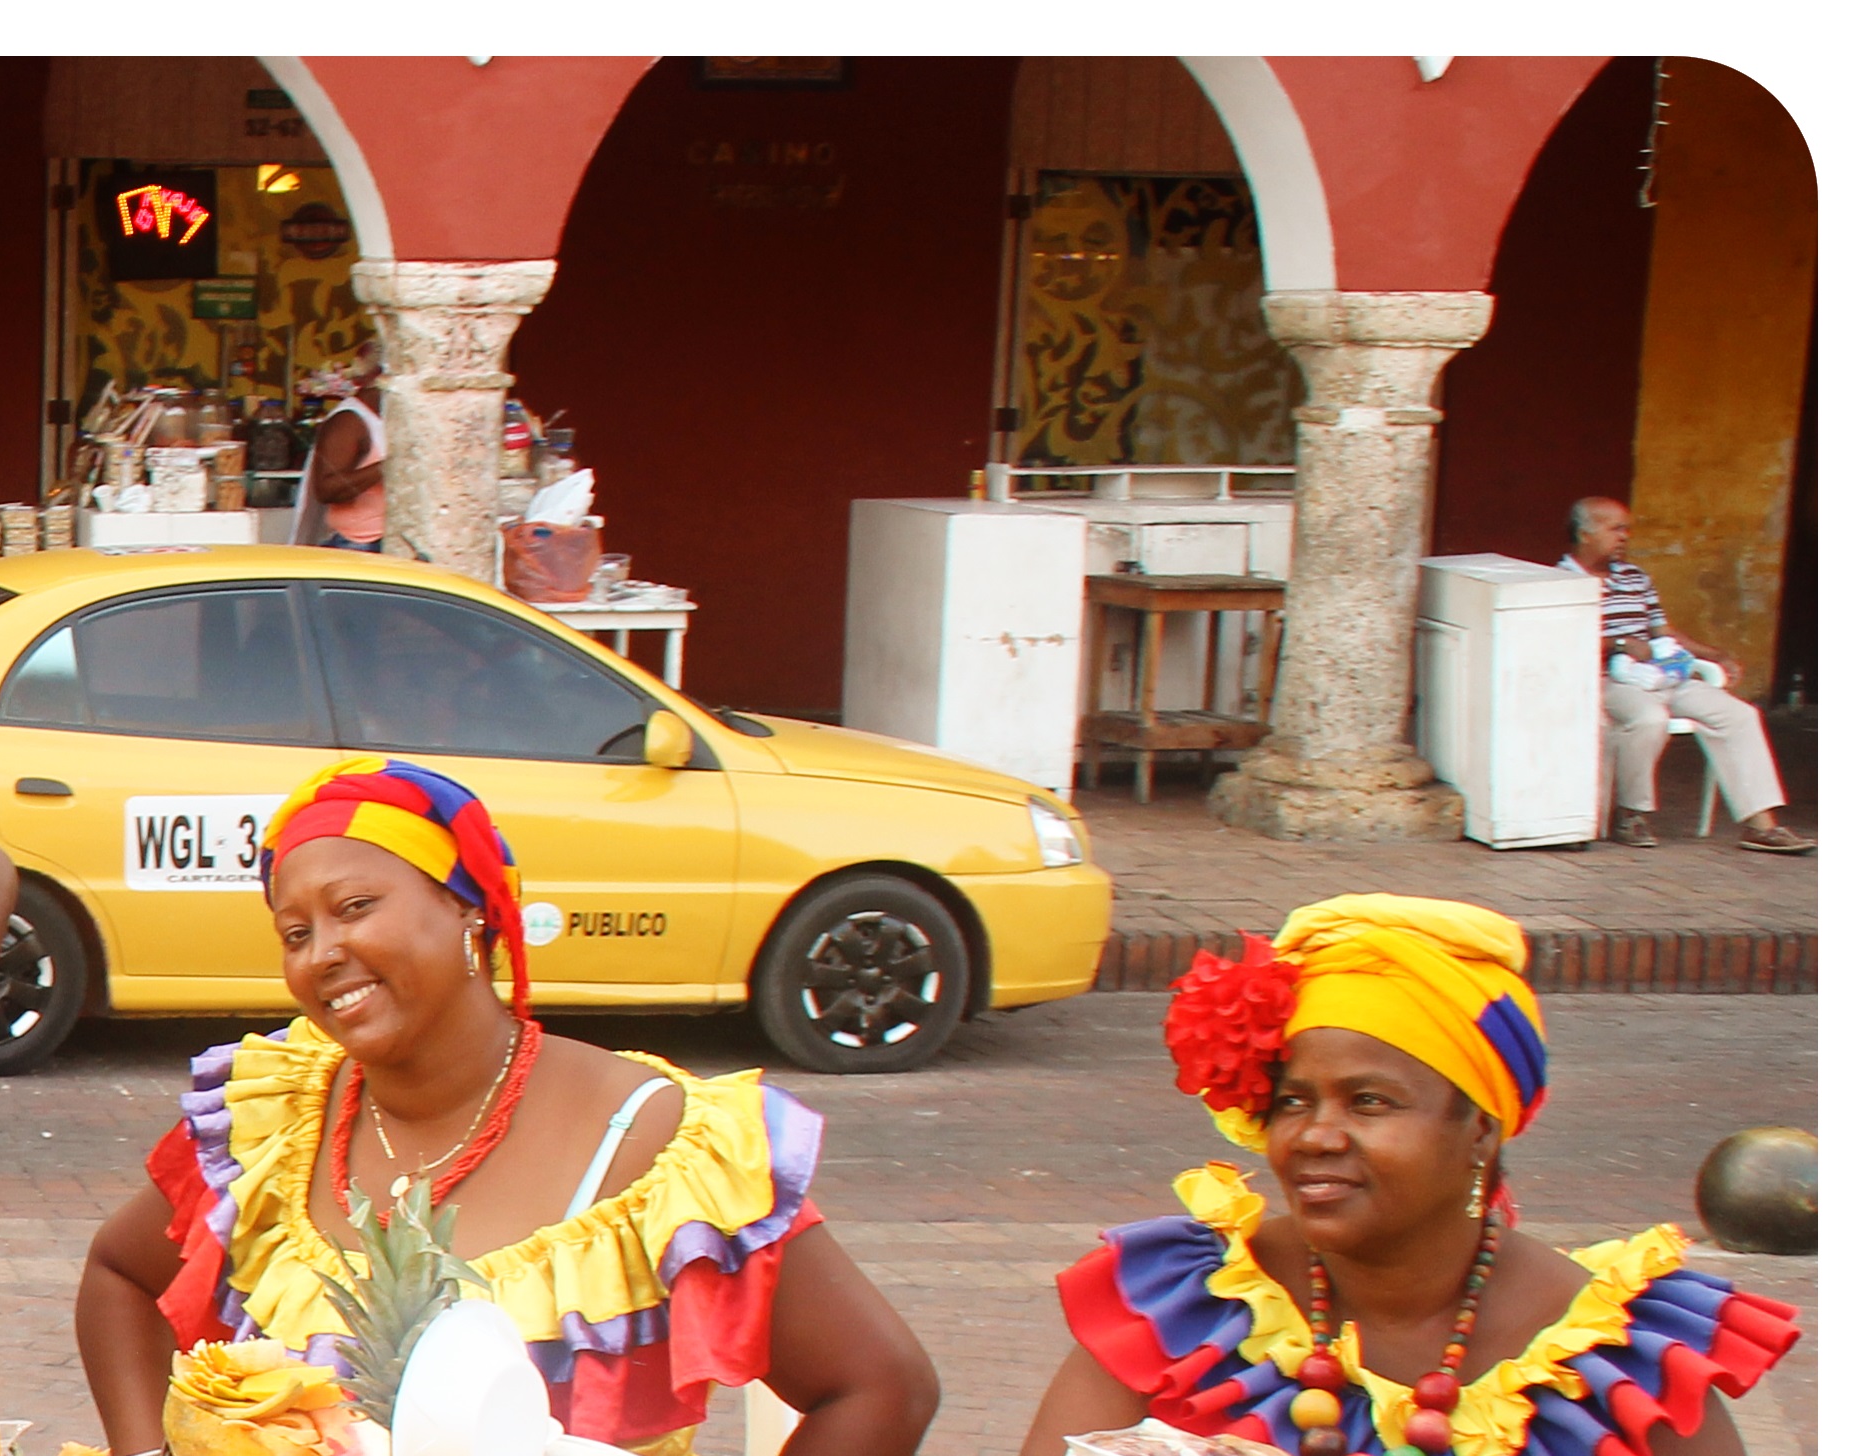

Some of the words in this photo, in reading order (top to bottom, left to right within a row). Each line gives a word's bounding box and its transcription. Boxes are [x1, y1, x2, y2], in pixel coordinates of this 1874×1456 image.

[136, 815, 216, 869] WGL
[166, 874, 263, 883] CARTAGEN
[567, 912, 667, 937] PUBLICO
